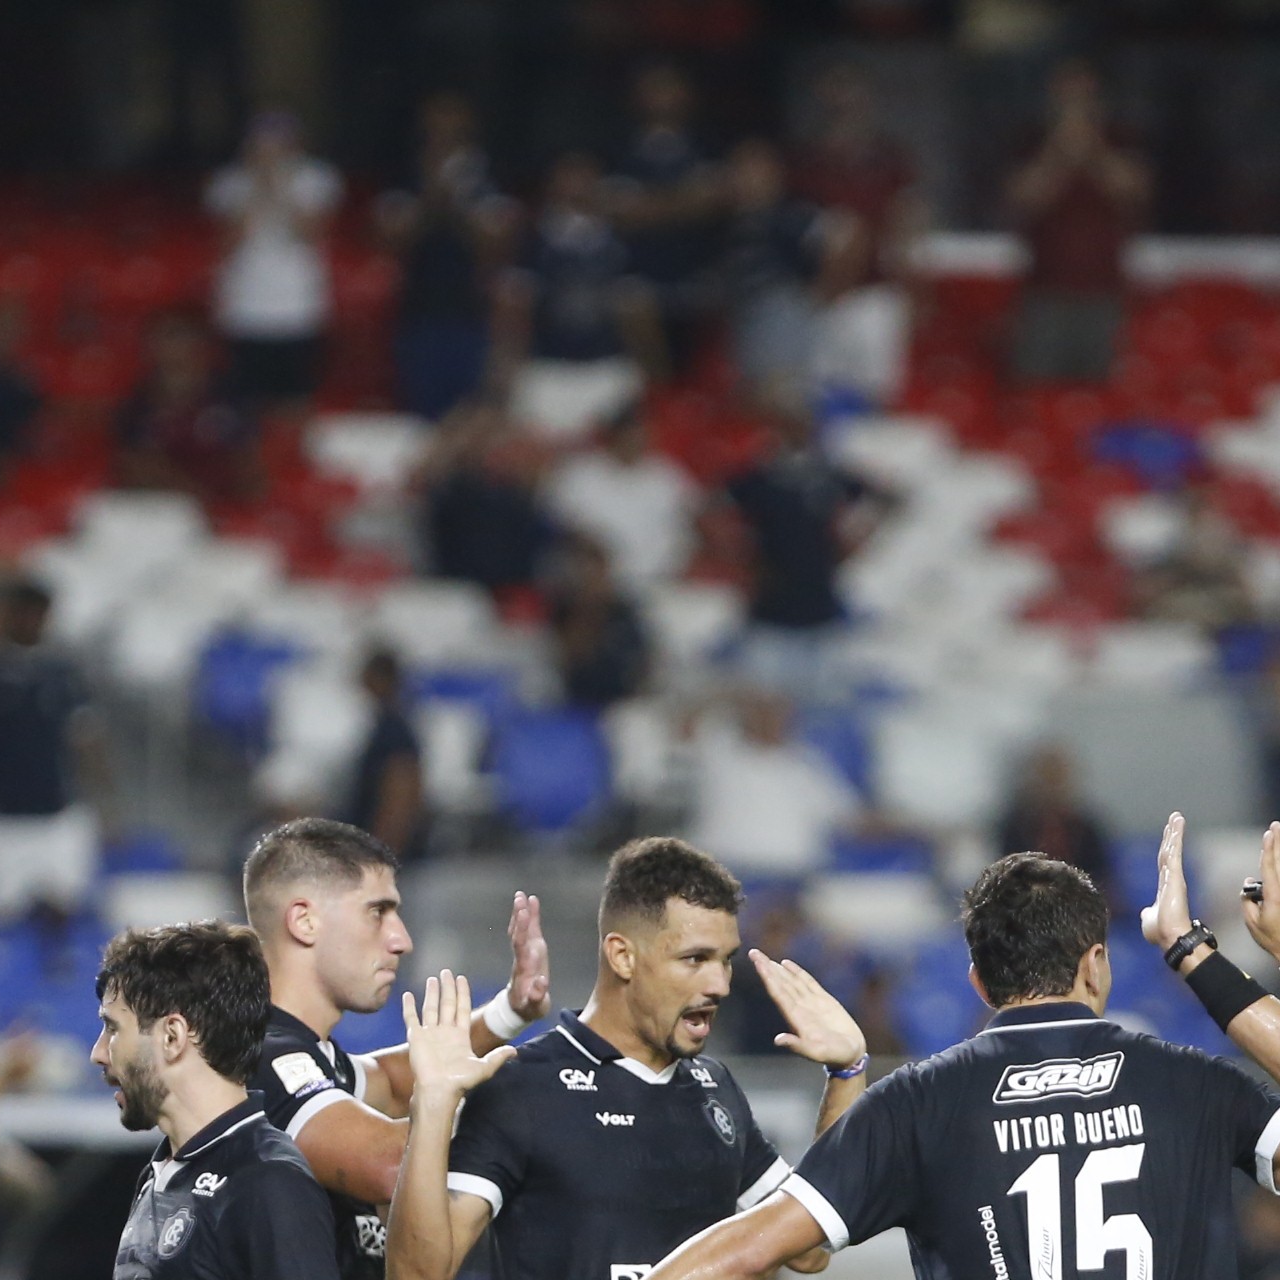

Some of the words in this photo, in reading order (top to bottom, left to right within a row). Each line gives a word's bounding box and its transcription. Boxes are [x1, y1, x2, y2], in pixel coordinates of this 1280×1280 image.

[559, 1068, 595, 1085] GAV
[596, 1112, 635, 1126] VOLT
[993, 1113, 1066, 1152] VITOR
[1074, 1103, 1145, 1144] BUENO
